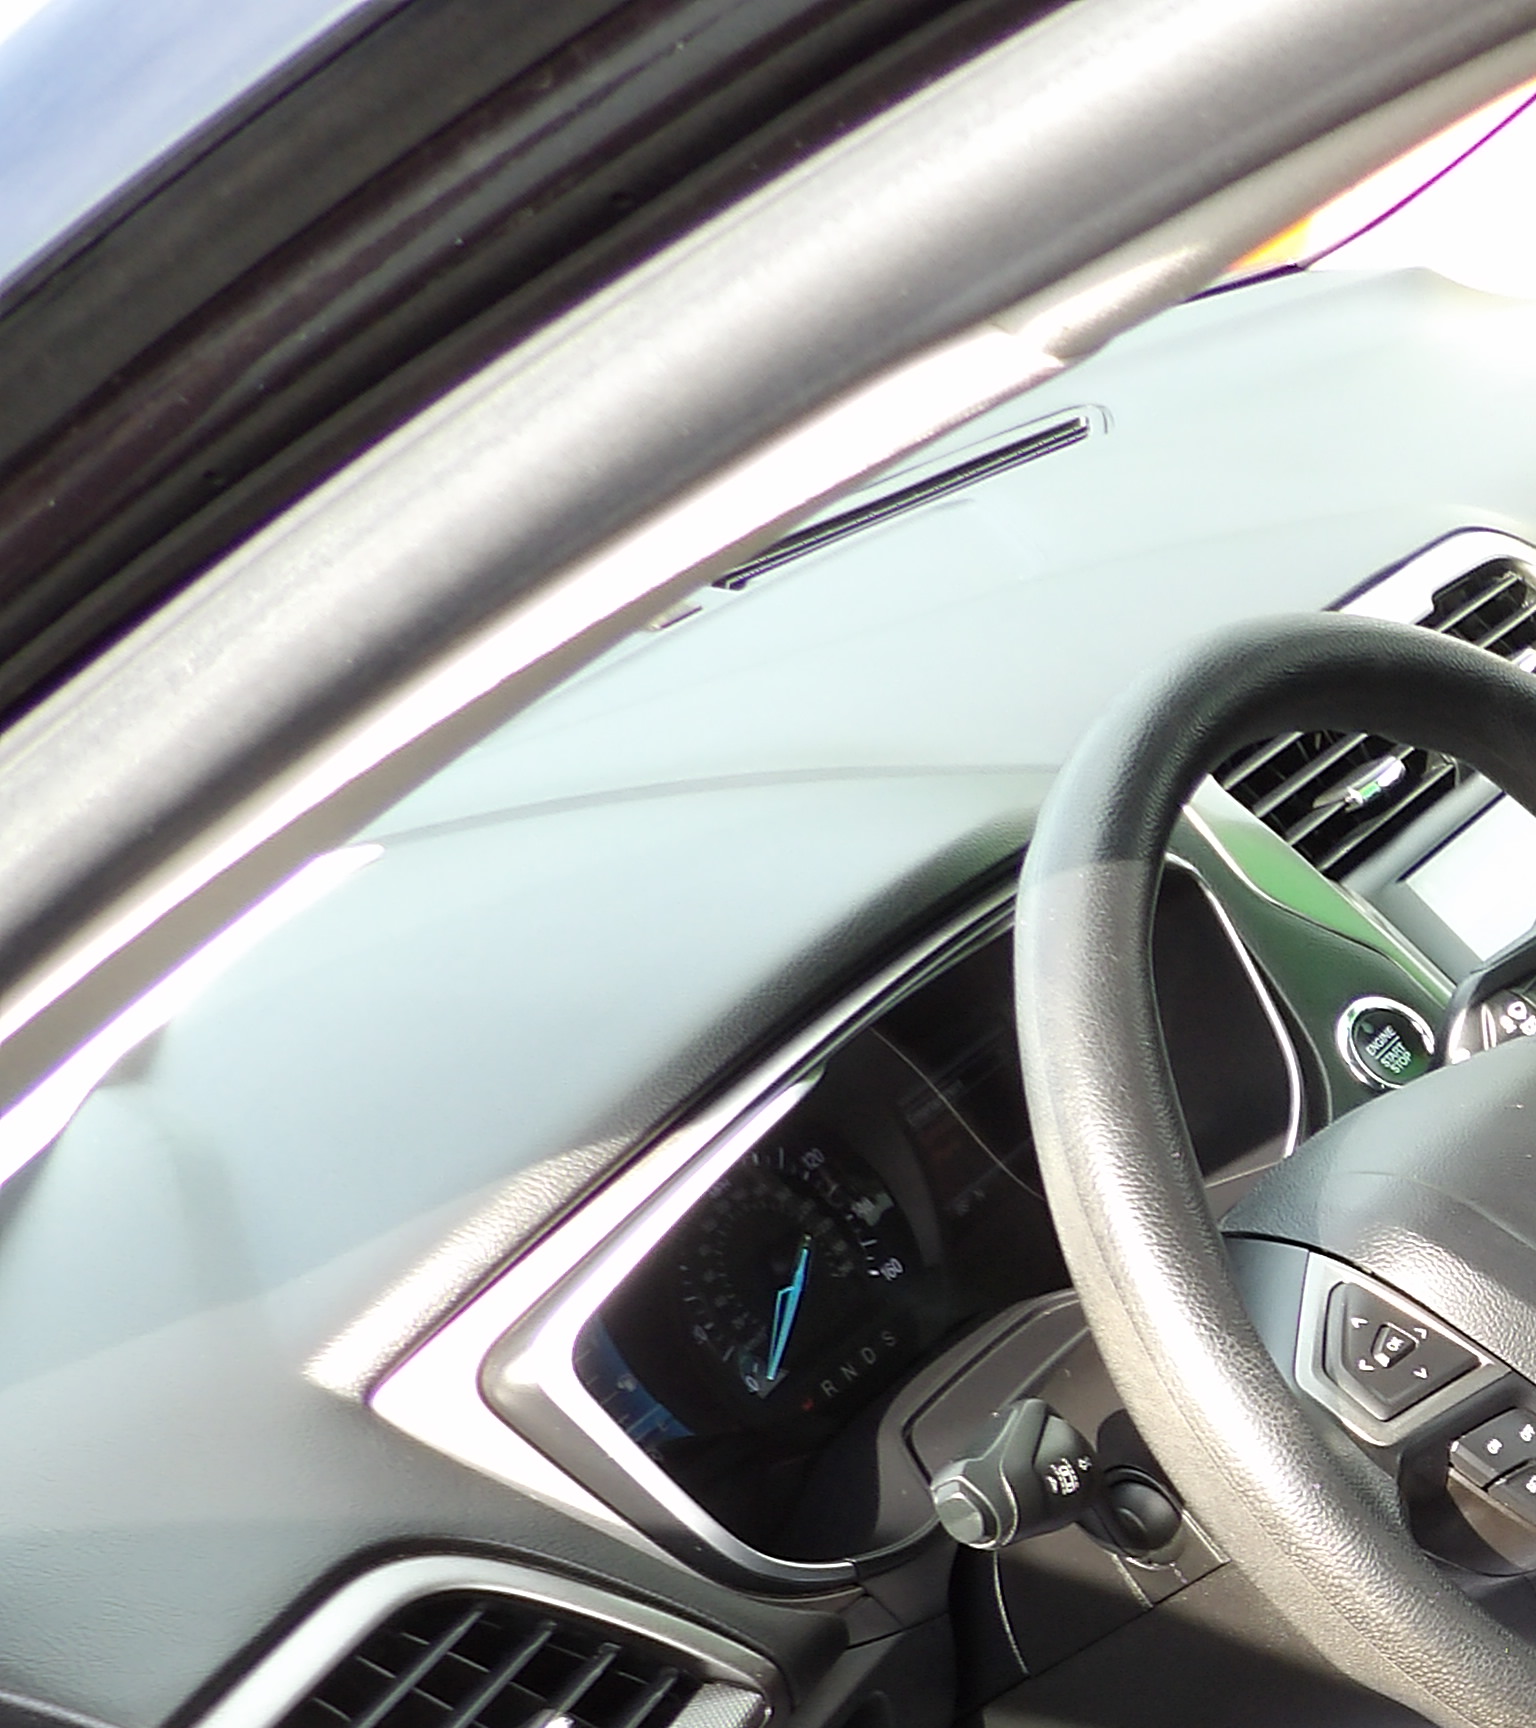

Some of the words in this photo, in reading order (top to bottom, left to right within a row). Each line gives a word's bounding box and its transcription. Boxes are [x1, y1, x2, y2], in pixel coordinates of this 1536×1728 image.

[1365, 1024, 1397, 1057] ENGINE
[1380, 1041, 1406, 1068] START
[1391, 1051, 1412, 1074] STOP
[820, 1378, 839, 1397] R
[840, 1363, 859, 1382] N
